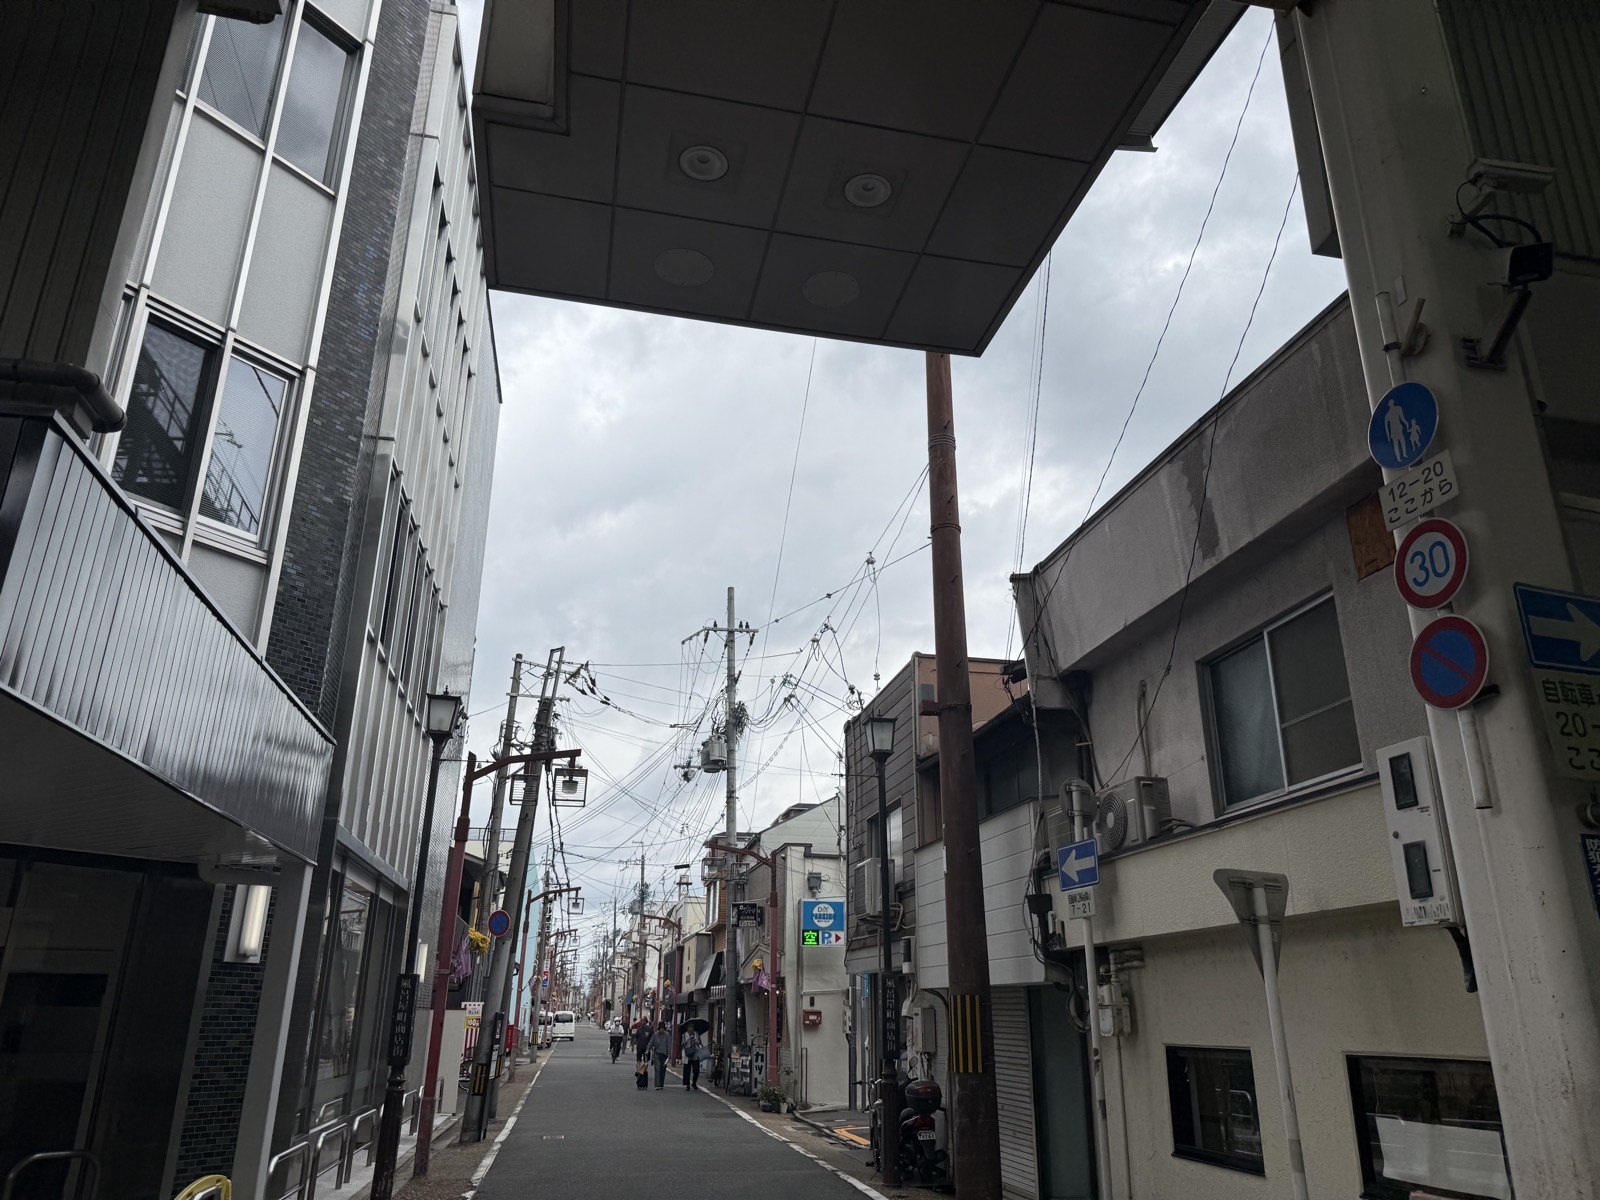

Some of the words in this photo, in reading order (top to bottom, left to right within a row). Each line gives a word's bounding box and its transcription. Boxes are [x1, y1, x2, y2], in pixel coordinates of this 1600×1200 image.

[1388, 460, 1444, 502] 12-20
[1387, 478, 1453, 524] ここから
[1410, 540, 1450, 588] 30
[1541, 678, 1600, 707] 自転車
[1071, 902, 1091, 915] 7-21
[804, 930, 817, 945] 空
[821, 931, 832, 945] P
